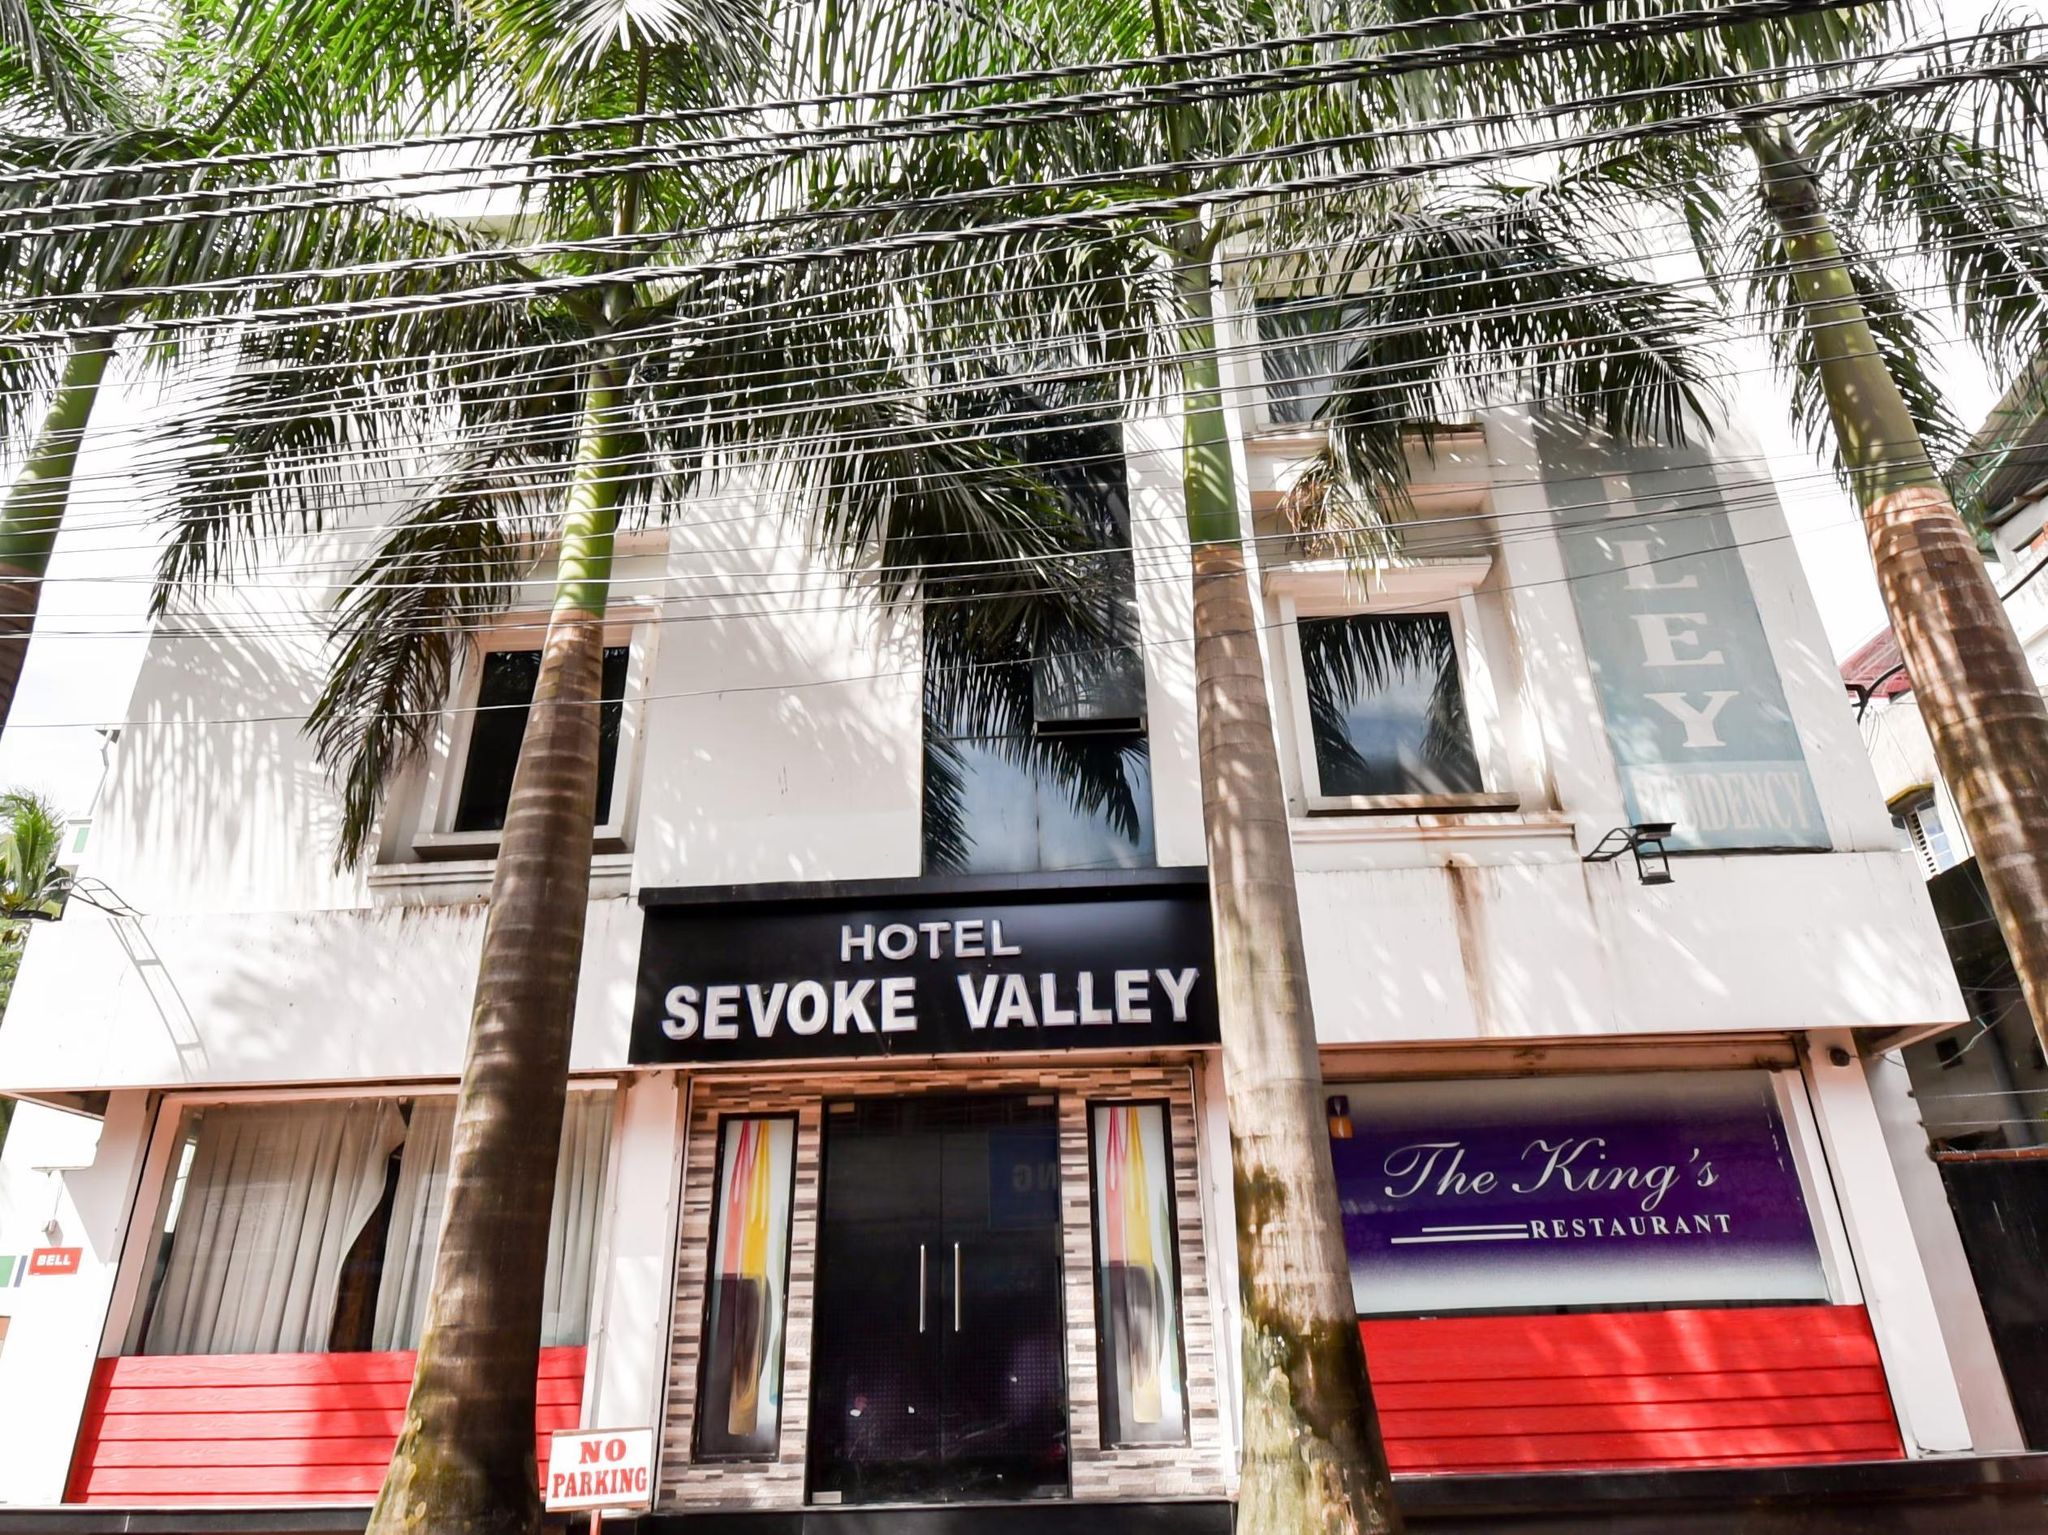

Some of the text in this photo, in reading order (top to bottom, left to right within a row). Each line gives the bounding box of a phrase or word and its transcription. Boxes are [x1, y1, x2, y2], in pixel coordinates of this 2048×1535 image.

[840, 919, 1022, 962] HOTEL
[661, 967, 1198, 1040] SEVOKE VALLEY
[1383, 1136, 1719, 1213] The King's
[1528, 1213, 1733, 1240] RESTAURANT
[36, 1253, 72, 1267] BELL
[578, 1437, 627, 1465] NO
[551, 1466, 648, 1499] PARKING
